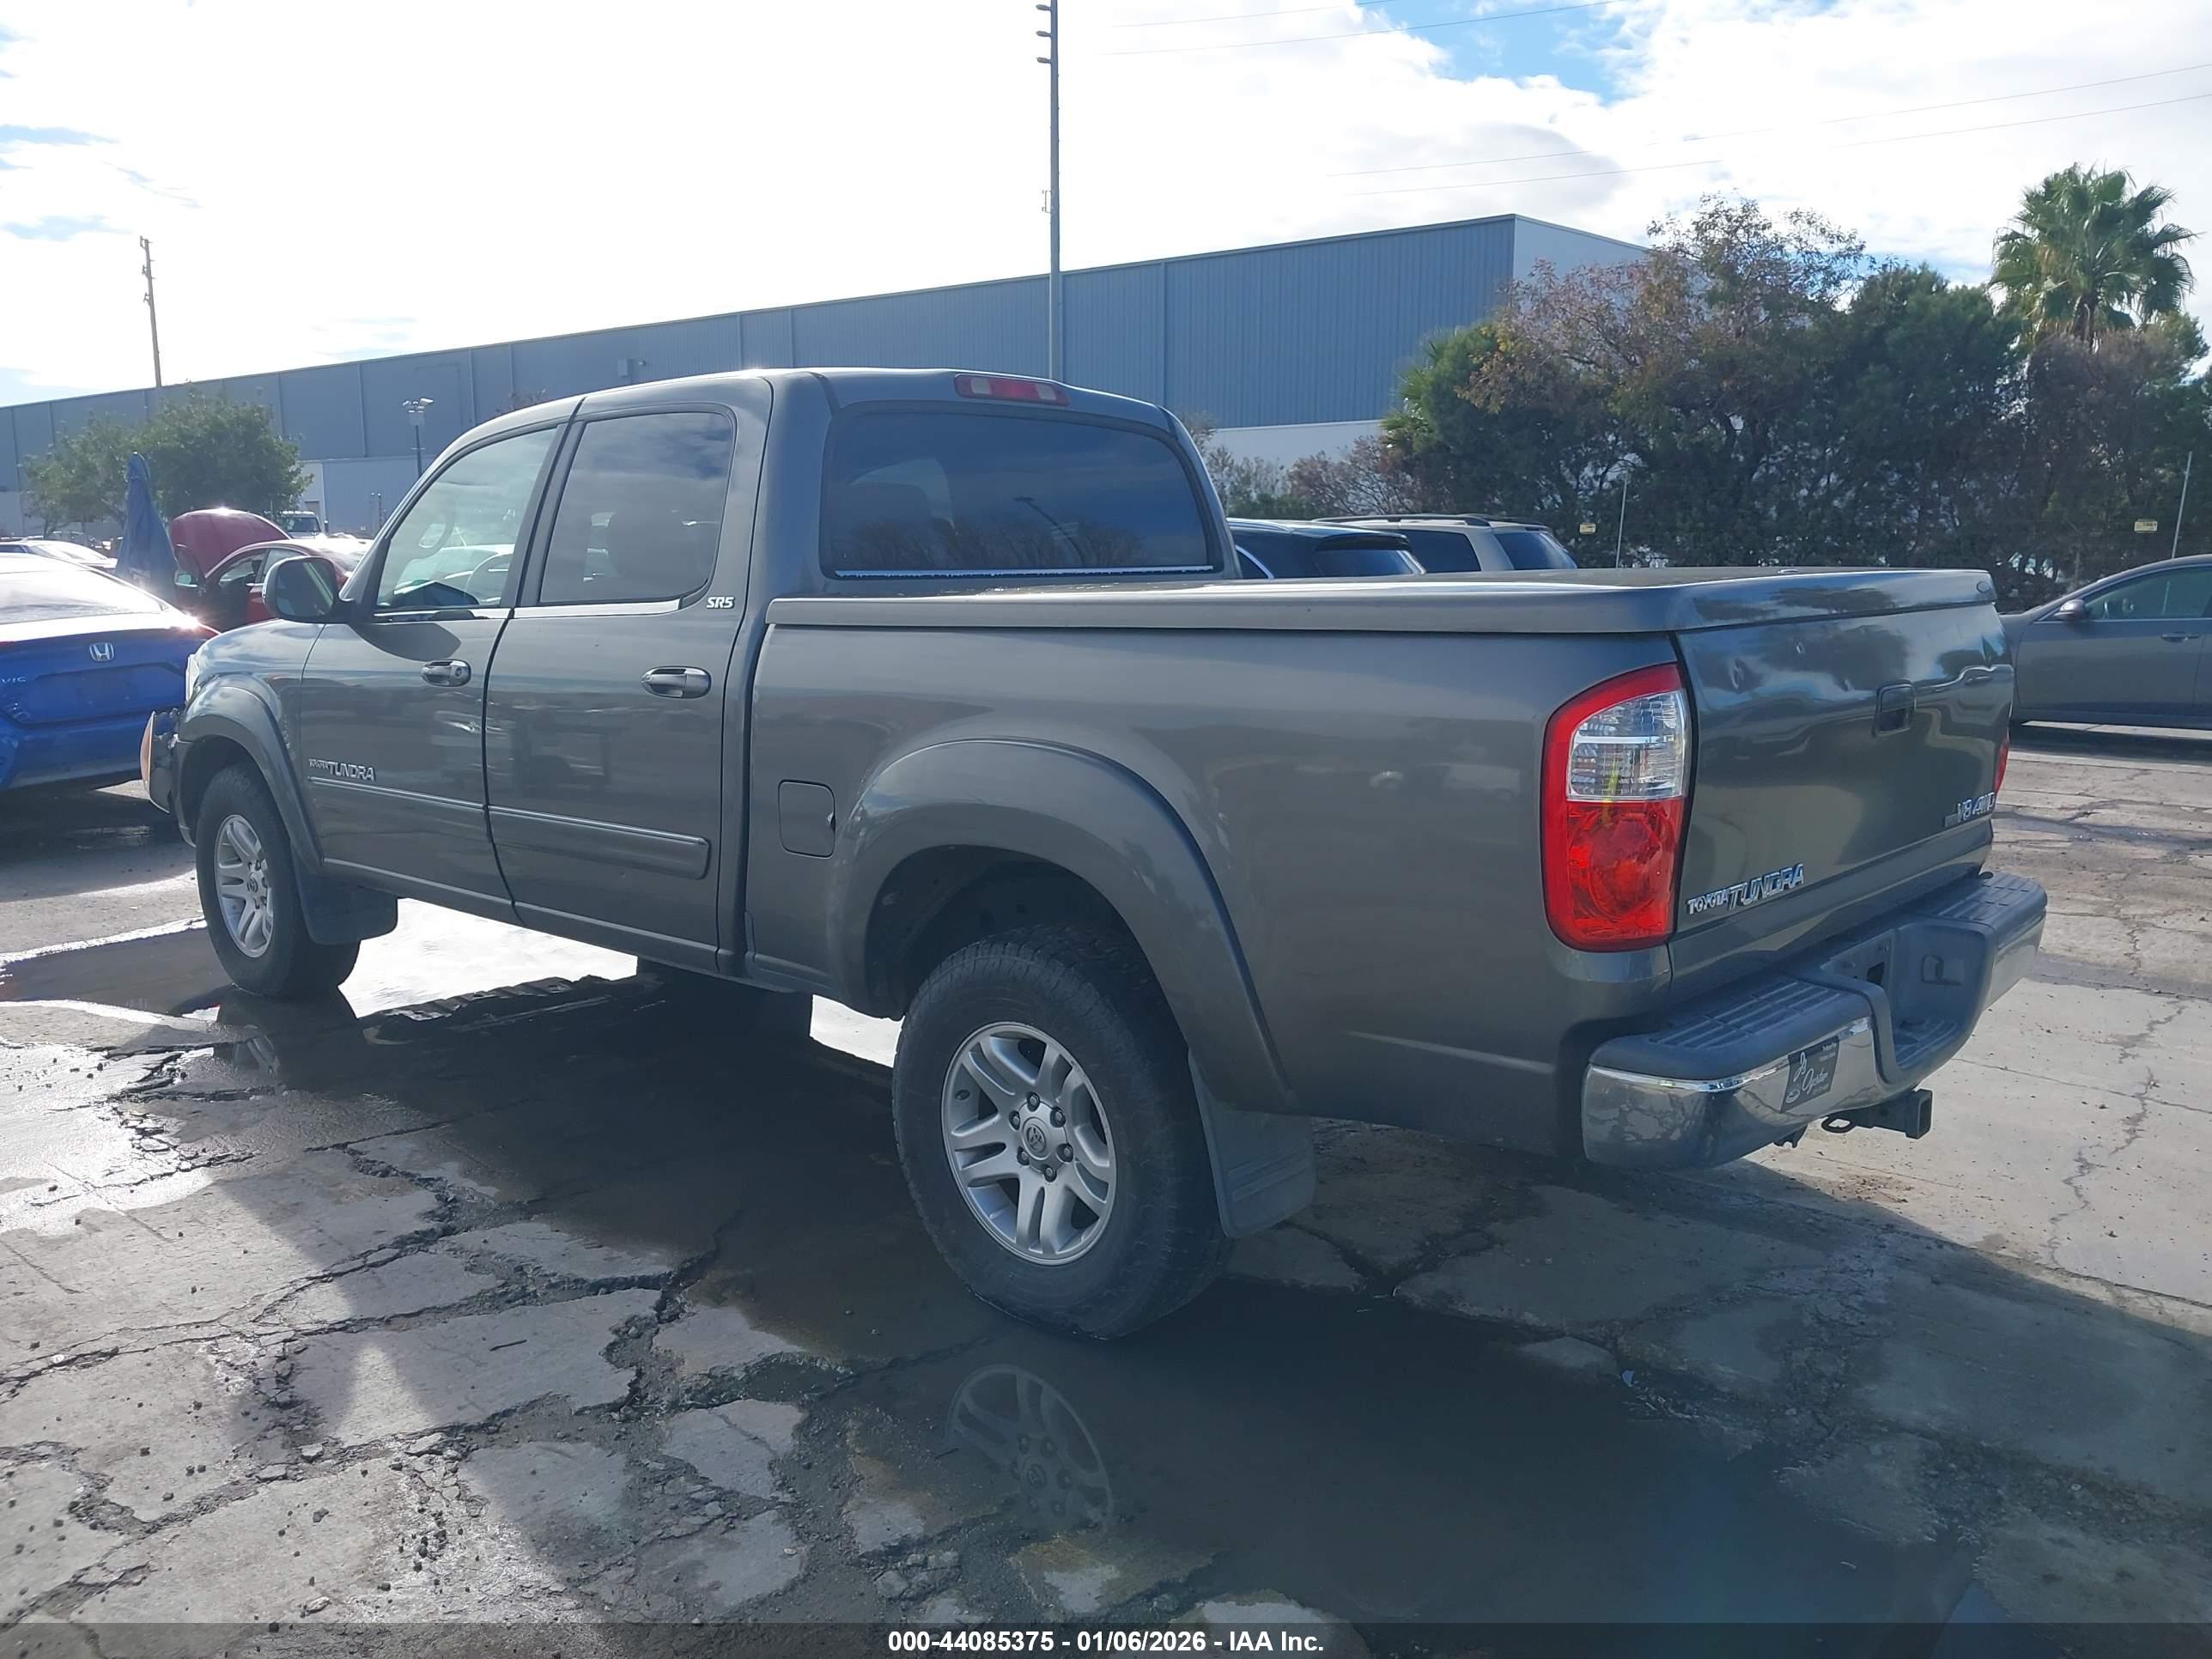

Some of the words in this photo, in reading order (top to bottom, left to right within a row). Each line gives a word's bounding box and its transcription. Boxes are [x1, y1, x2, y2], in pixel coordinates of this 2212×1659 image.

[706, 596, 734, 609] SR5
[328, 761, 374, 782] TUNDRA
[1686, 890, 1729, 915] TOYOTA
[1728, 863, 1804, 911] TUNDRA
